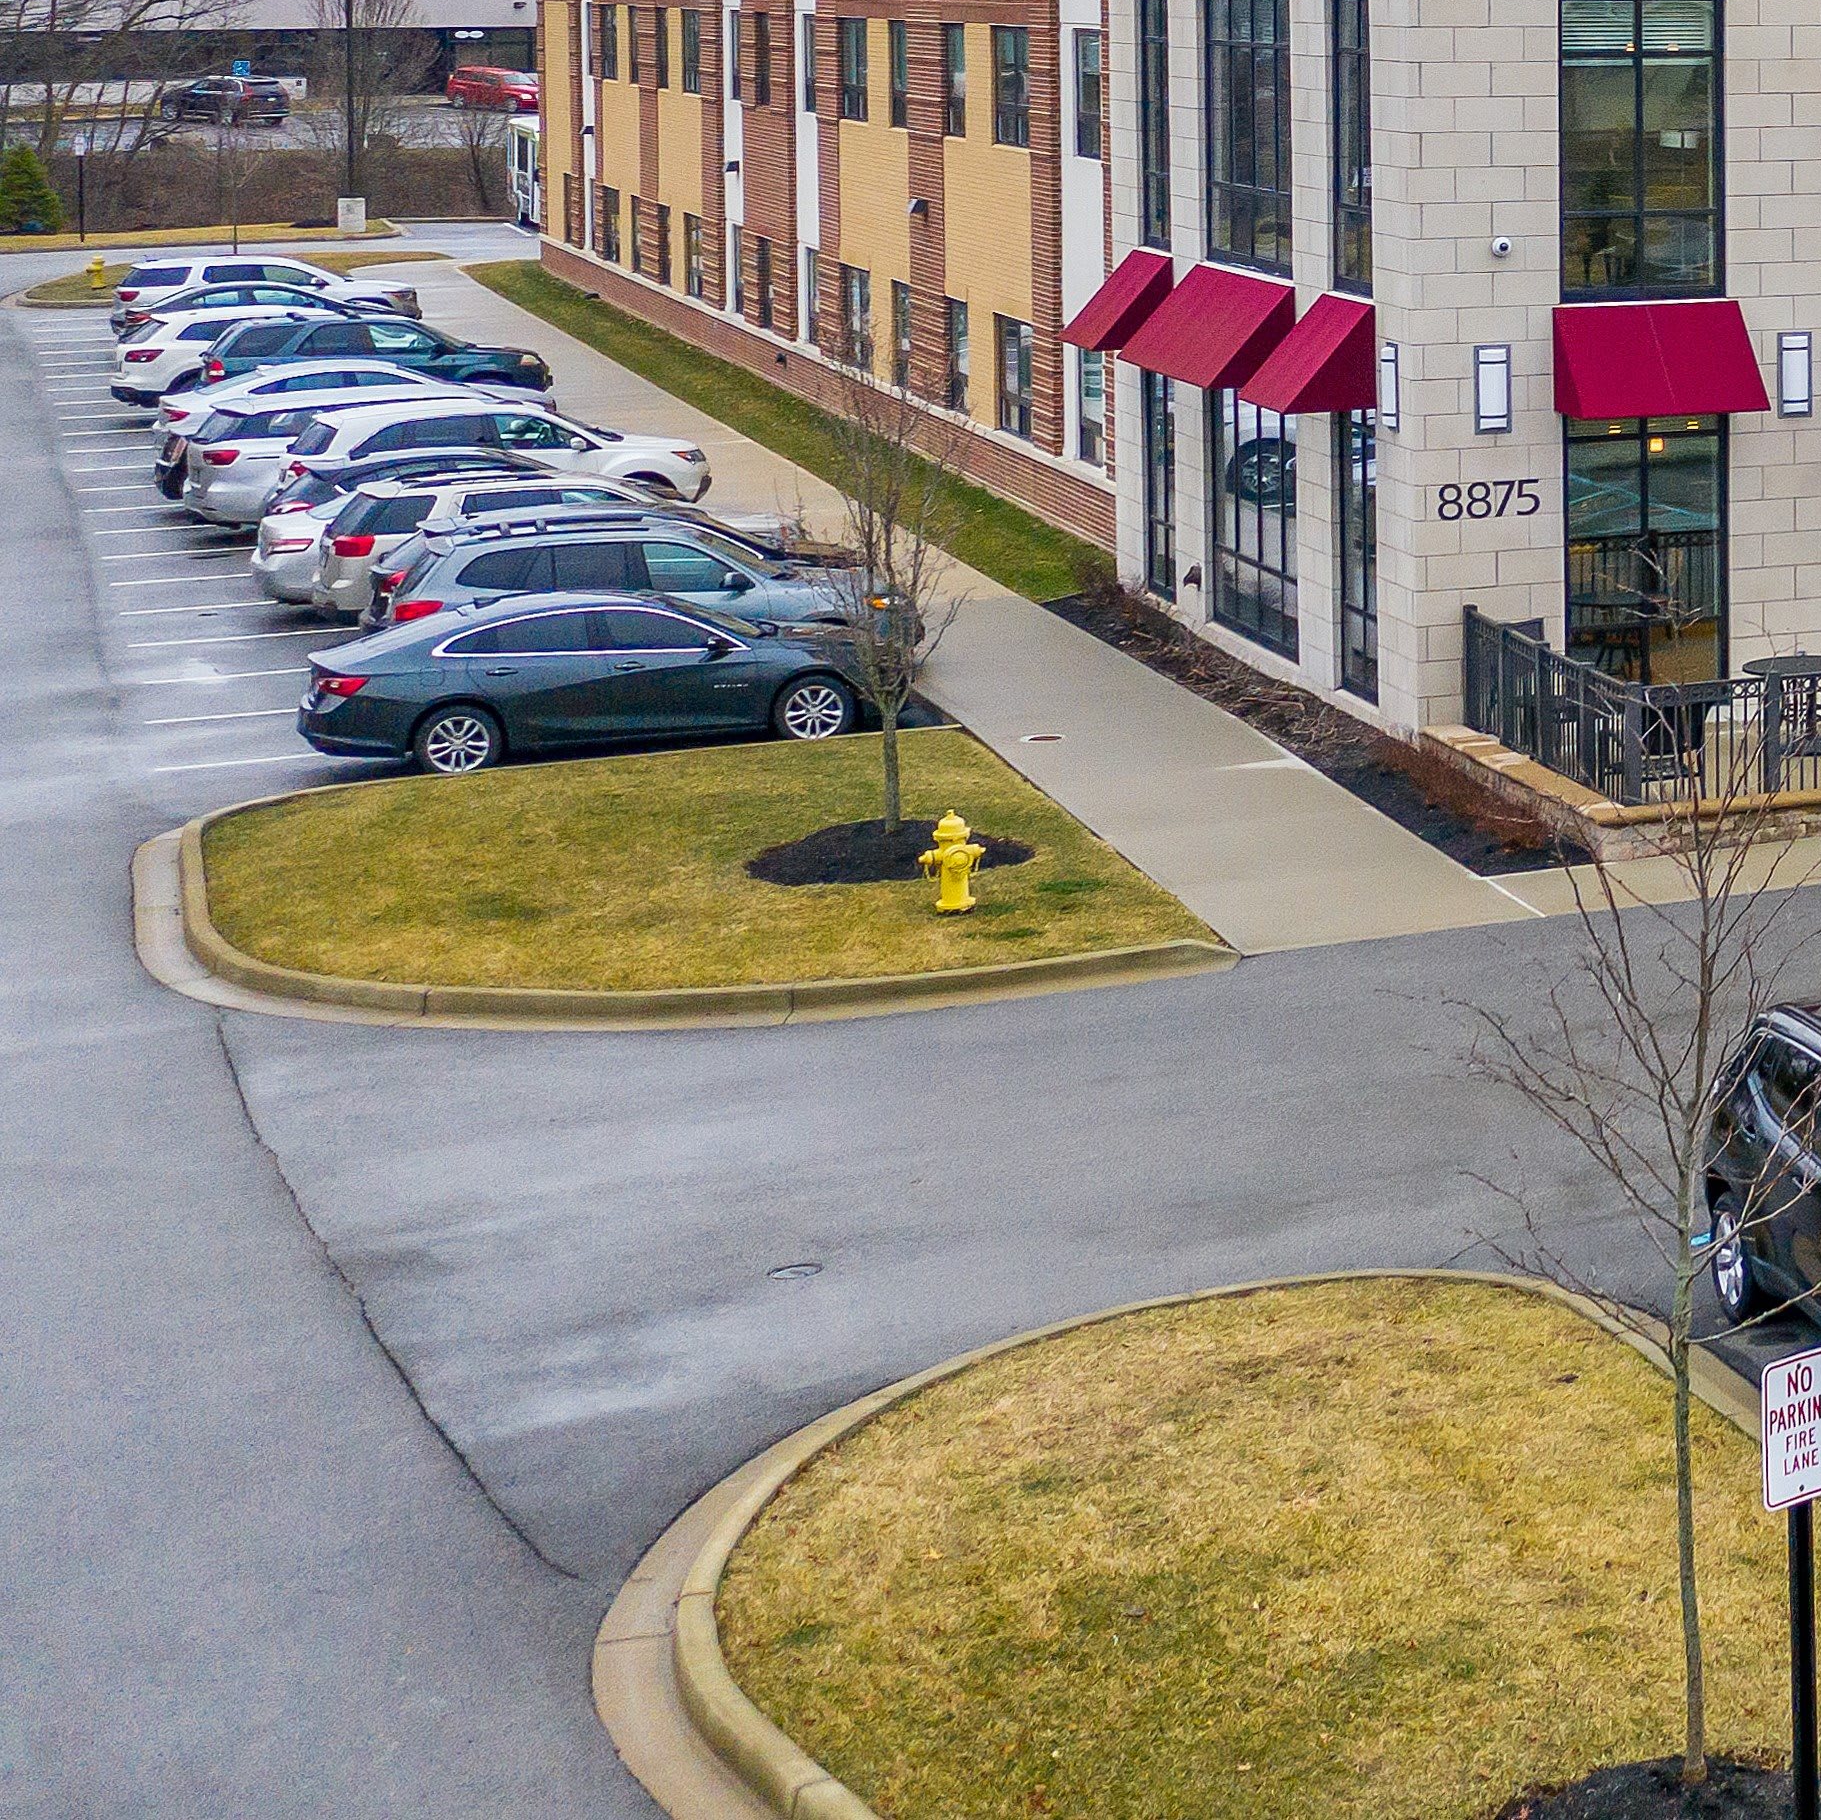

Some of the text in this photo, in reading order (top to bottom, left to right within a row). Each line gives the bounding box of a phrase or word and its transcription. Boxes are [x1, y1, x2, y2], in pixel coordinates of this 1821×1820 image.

[1437, 479, 1541, 521] 8875
[1787, 1366, 1812, 1396] NO
[1785, 1427, 1816, 1453] FIRE
[1783, 1449, 1819, 1476] LANE
